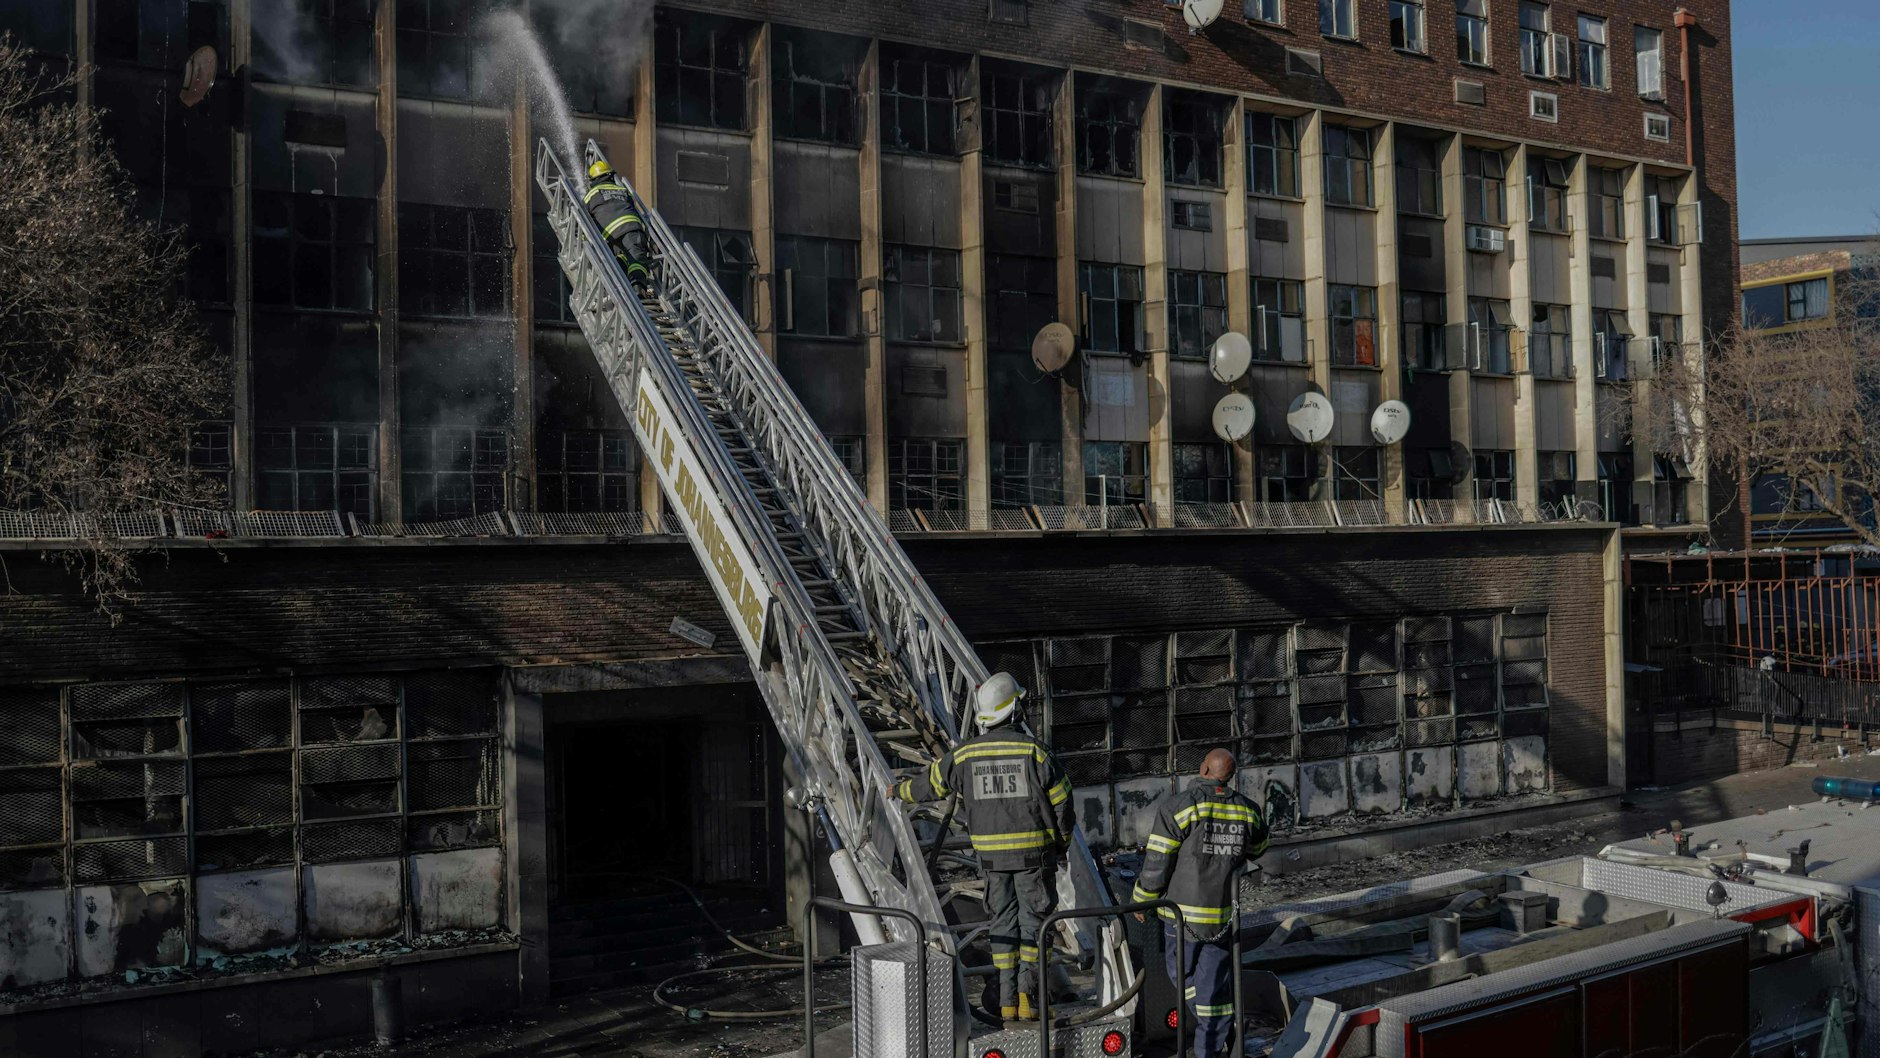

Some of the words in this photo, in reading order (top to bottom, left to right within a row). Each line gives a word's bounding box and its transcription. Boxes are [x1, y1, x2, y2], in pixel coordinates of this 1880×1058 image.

[638, 387, 660, 449] CITY
[661, 427, 674, 476] OF
[674, 456, 764, 650] JOHANNESBURG
[974, 764, 1021, 776] JOHANNESBURG
[982, 774, 1017, 794] E.M.S
[1228, 823, 1244, 834] OF
[1202, 843, 1242, 856] EMS
